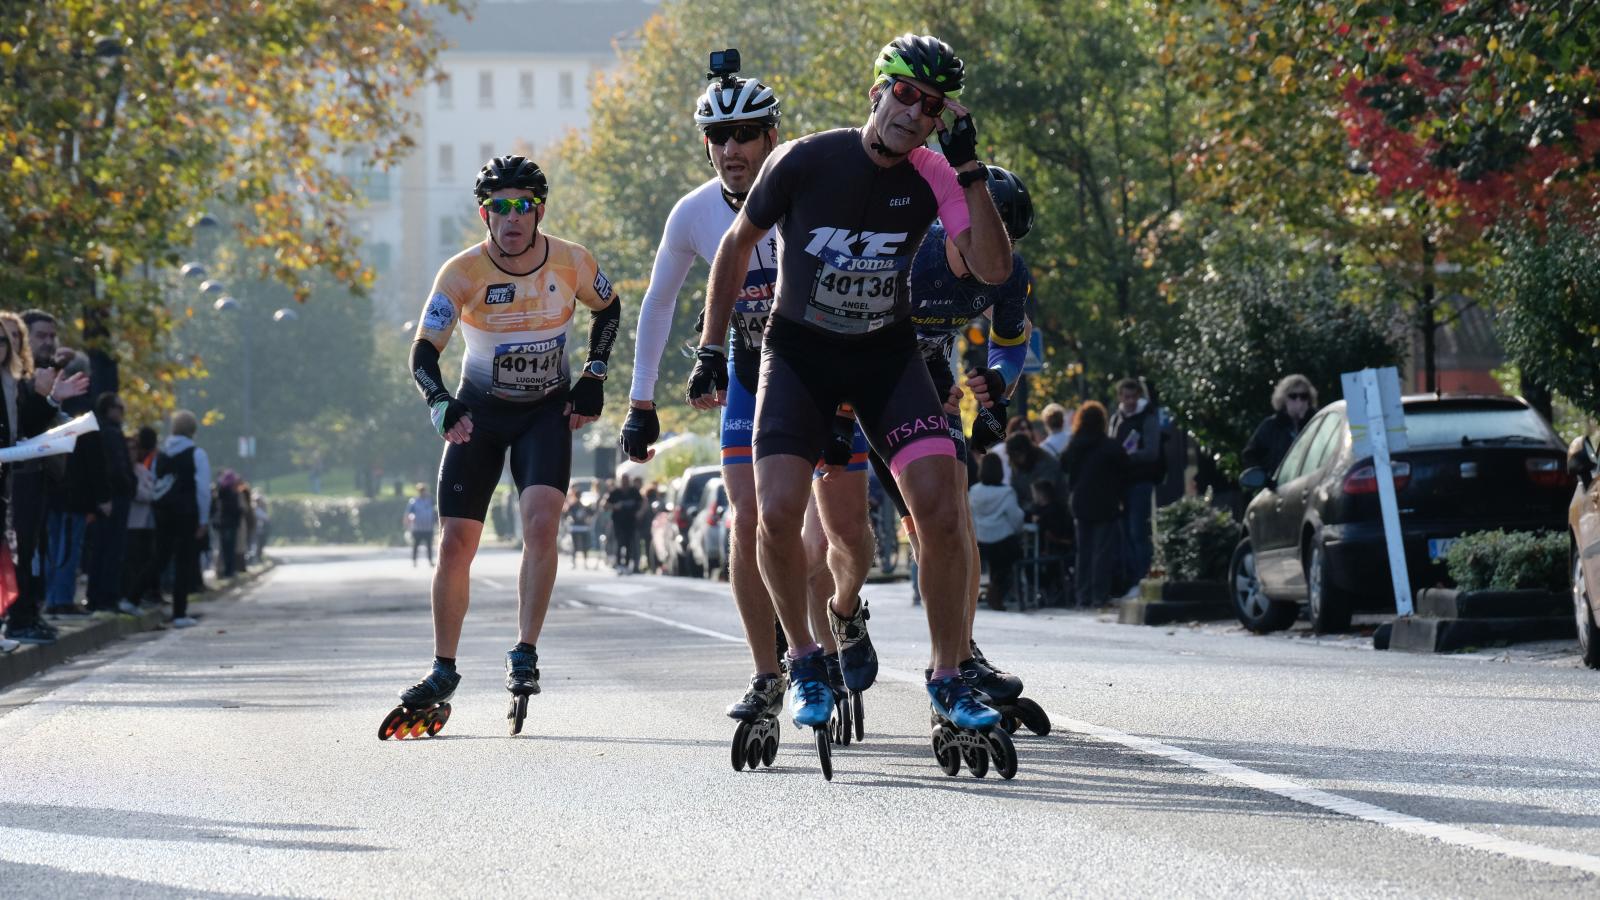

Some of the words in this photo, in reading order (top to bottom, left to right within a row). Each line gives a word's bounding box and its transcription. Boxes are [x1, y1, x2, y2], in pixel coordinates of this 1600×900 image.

[821, 273, 895, 297] 40138
[841, 301, 870, 310] ANGEL
[500, 352, 557, 373] 40141
